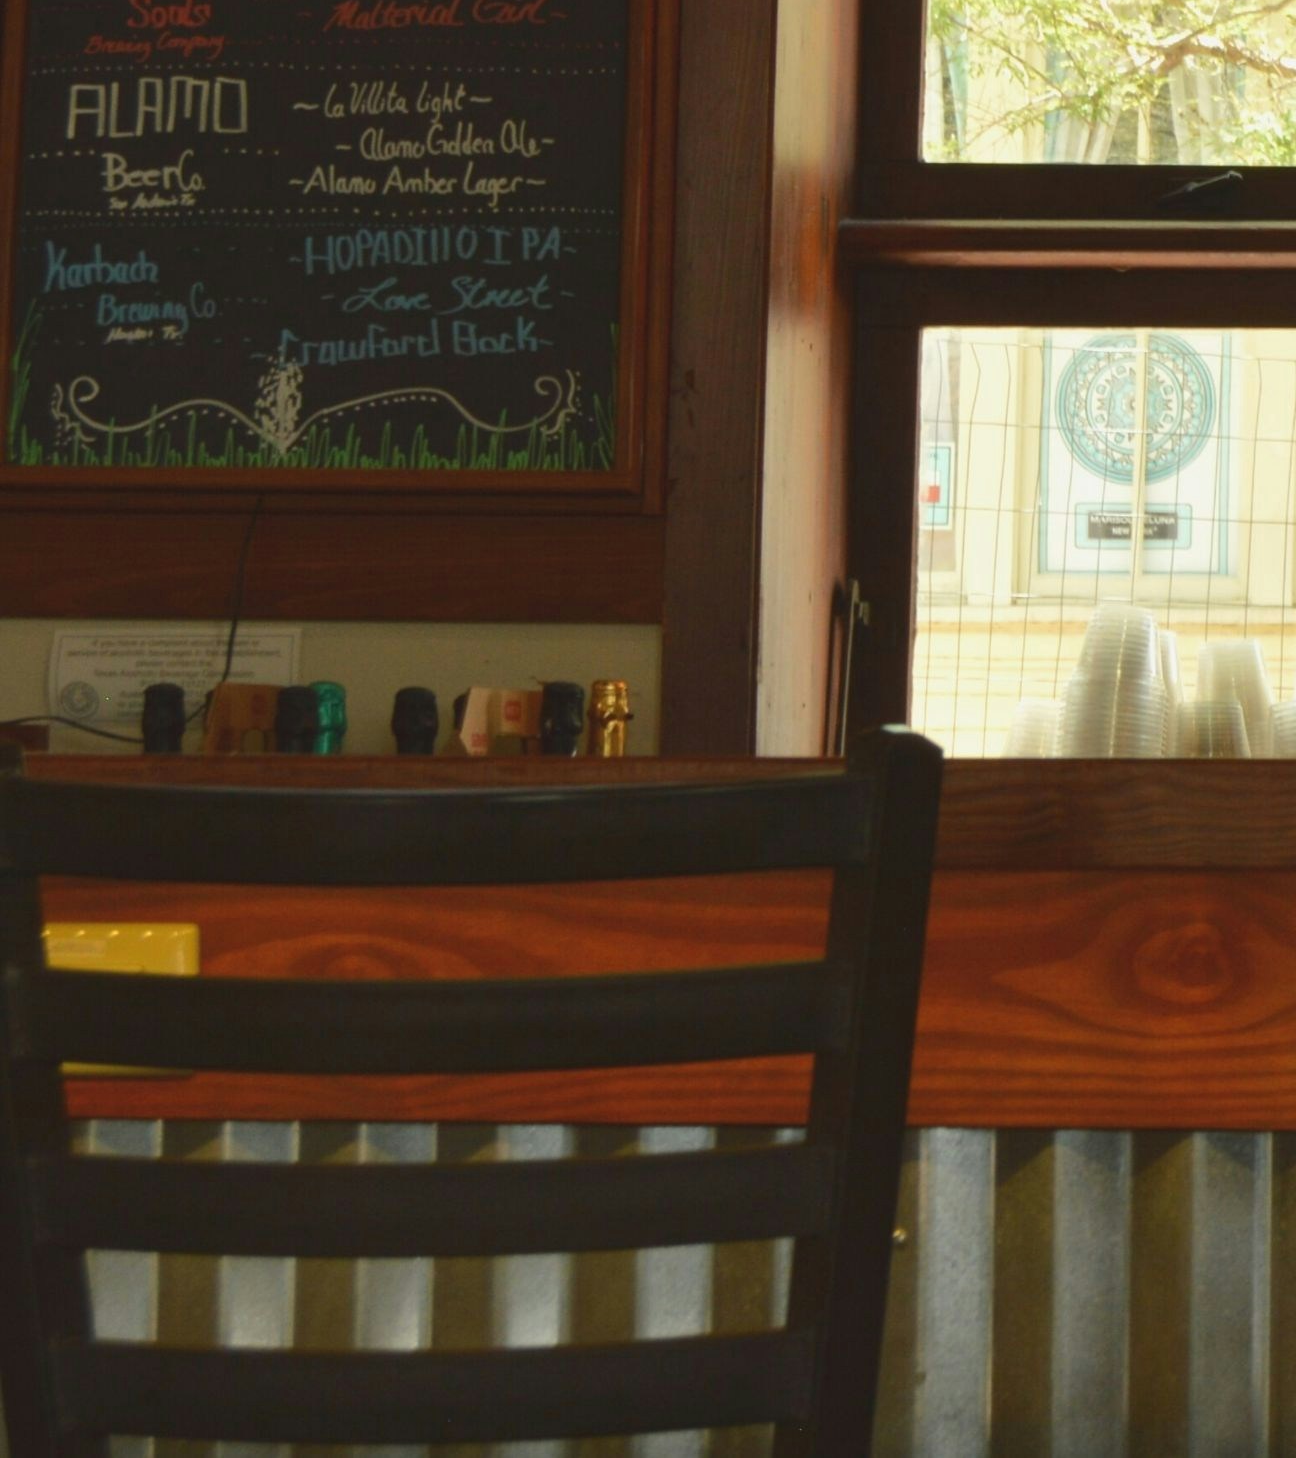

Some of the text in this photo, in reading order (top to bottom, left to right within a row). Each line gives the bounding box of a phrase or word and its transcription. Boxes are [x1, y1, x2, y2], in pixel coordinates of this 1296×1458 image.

[66, 76, 249, 139] ALAMO
[101, 151, 179, 193] Beer
[303, 160, 525, 207] Alamo Amber Lager
[342, 273, 554, 316] Love Street
[451, 314, 540, 356] Bock
